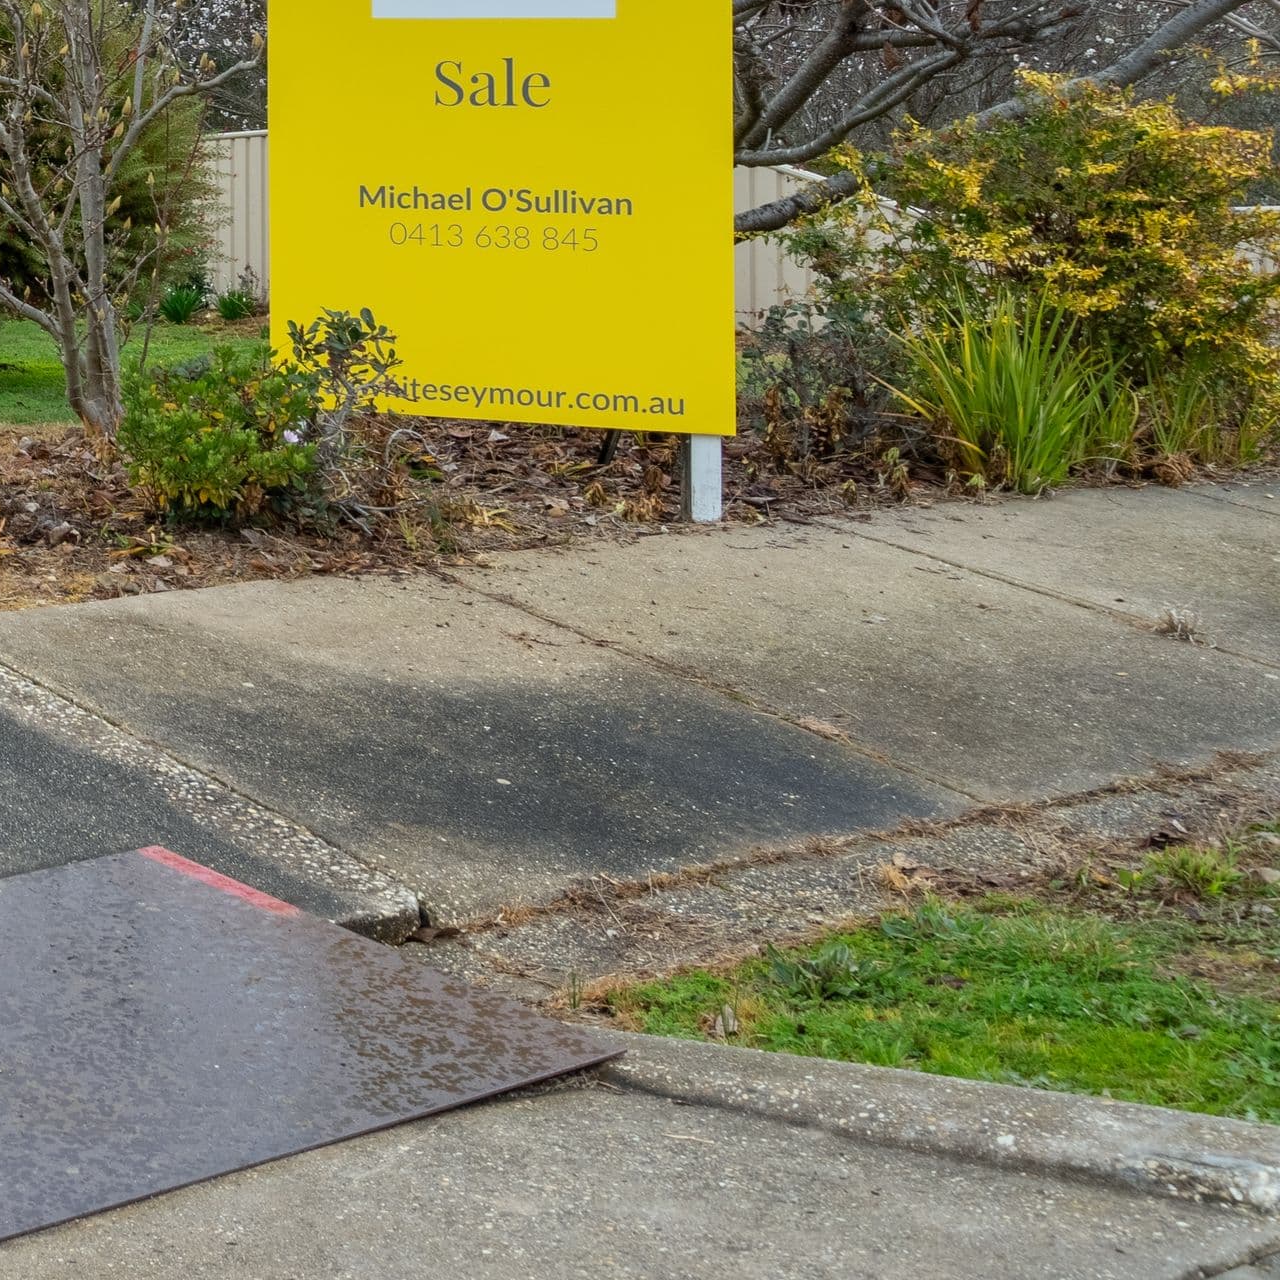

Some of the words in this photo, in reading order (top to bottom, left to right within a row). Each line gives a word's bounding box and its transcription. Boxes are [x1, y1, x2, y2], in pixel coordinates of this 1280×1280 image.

[434, 57, 551, 108] Sale
[359, 184, 472, 211] Michael
[481, 188, 633, 216] O'Sullivan
[389, 221, 464, 249] 0413
[475, 223, 531, 250] 638
[542, 226, 599, 252] 845
